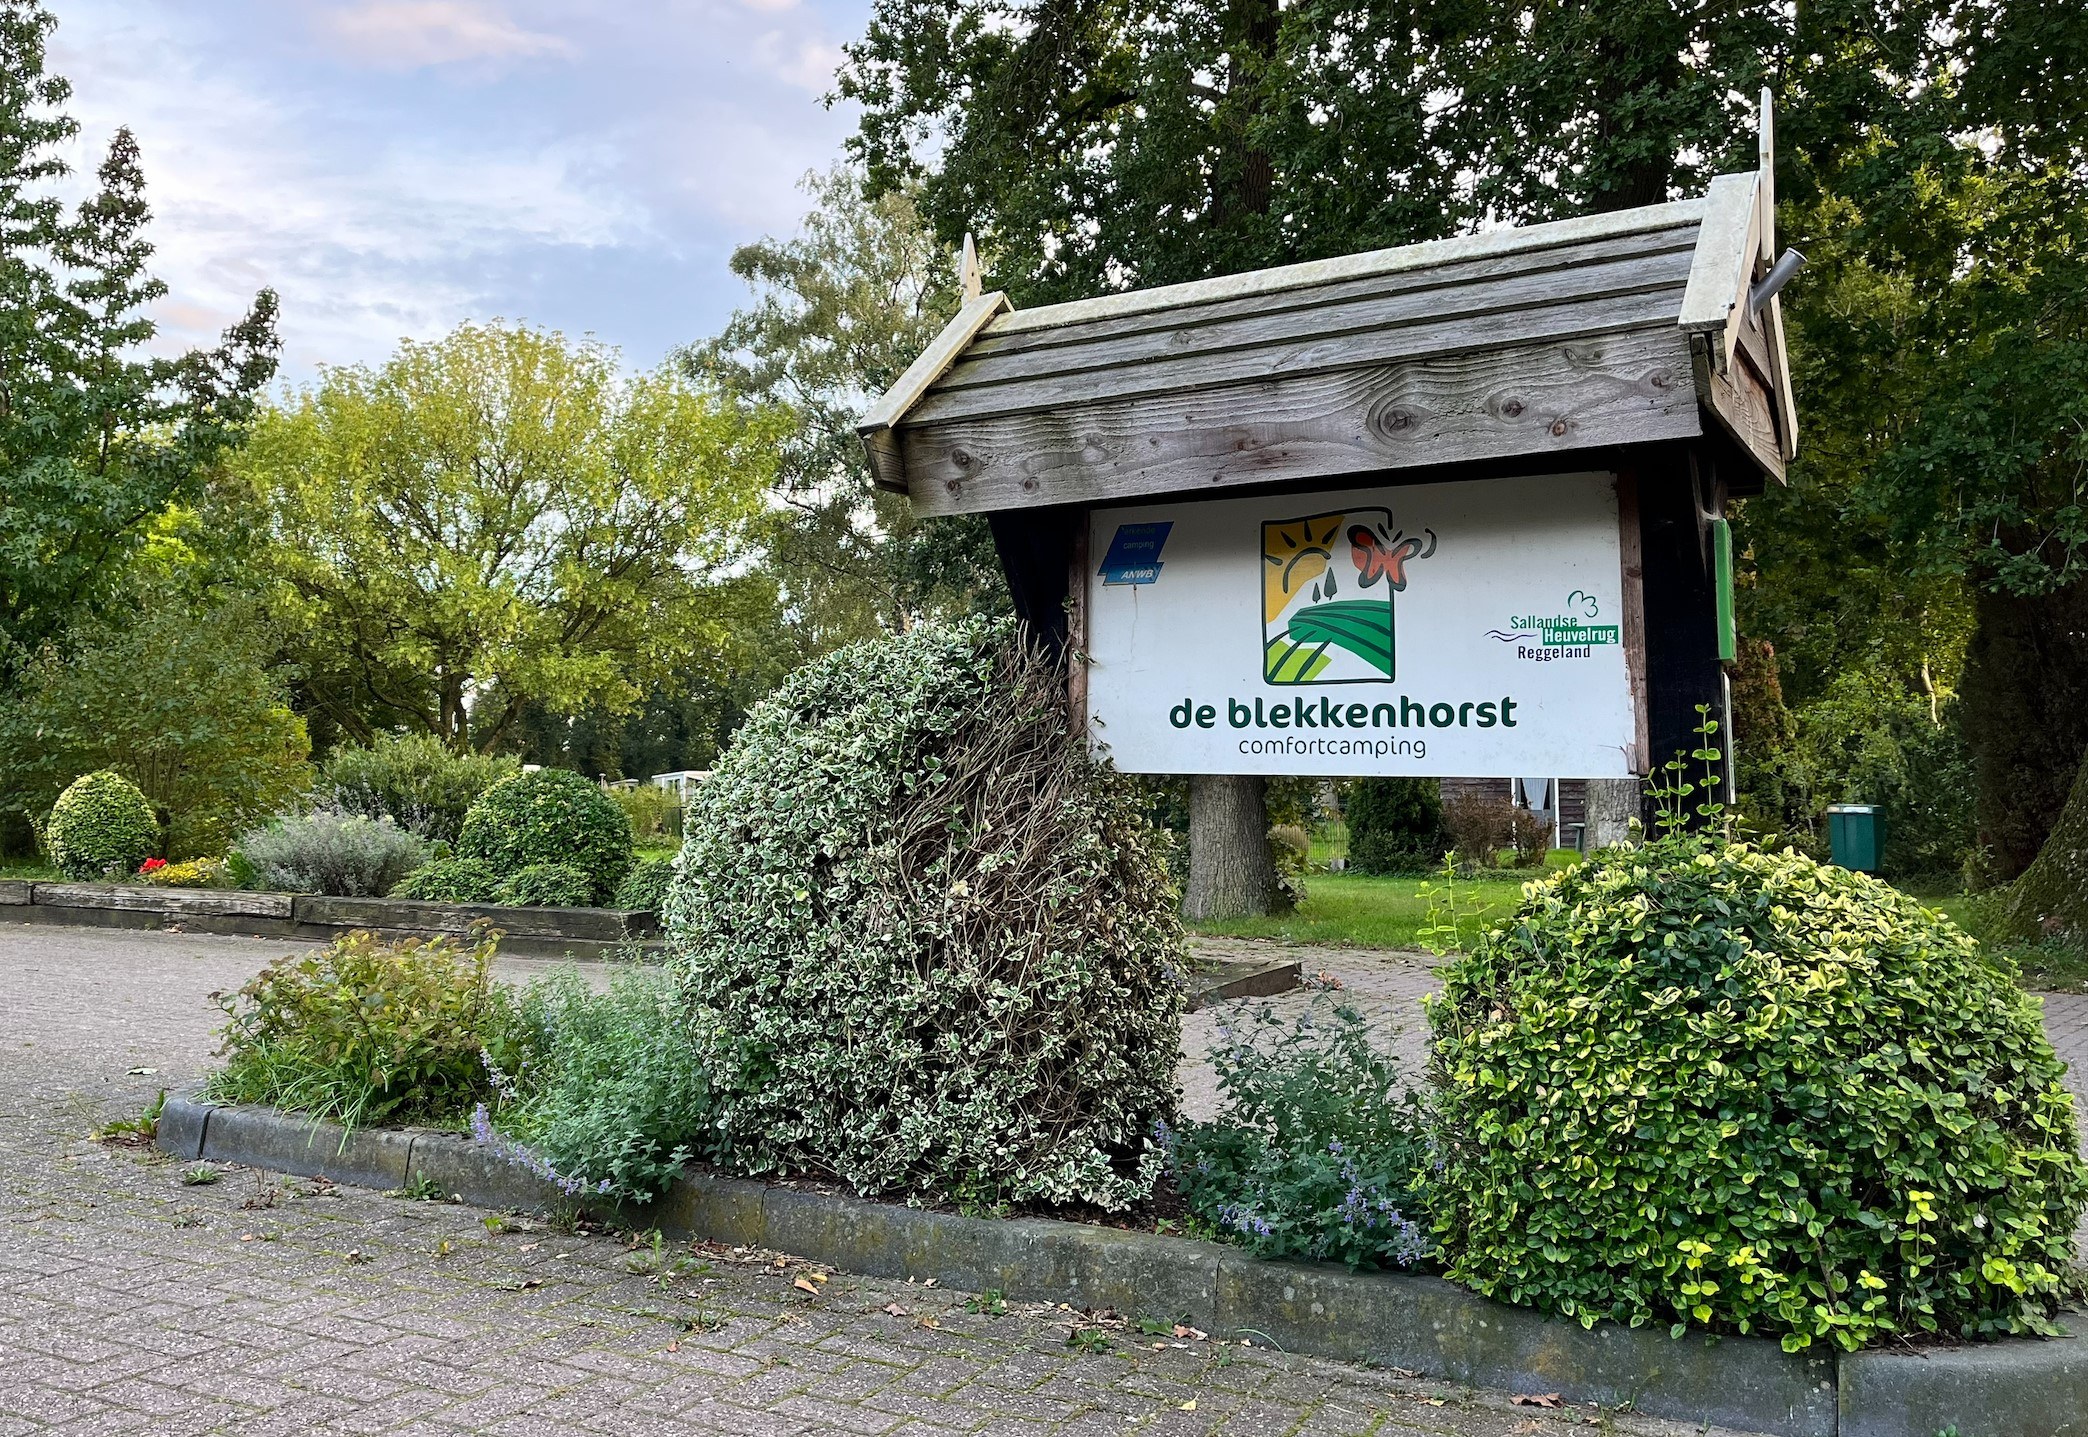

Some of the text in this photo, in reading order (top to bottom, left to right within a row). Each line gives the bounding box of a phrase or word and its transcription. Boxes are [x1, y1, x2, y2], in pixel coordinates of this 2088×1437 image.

[1123, 541, 1155, 550] camping
[1121, 569, 1154, 579] ANWB
[1510, 614, 1578, 629] Sallandse
[1544, 627, 1616, 644] Heuvelrug
[1518, 644, 1591, 662] Reggeland
[1169, 695, 1518, 729] de blekkenhorst
[1238, 736, 1427, 759] comfortcamping
